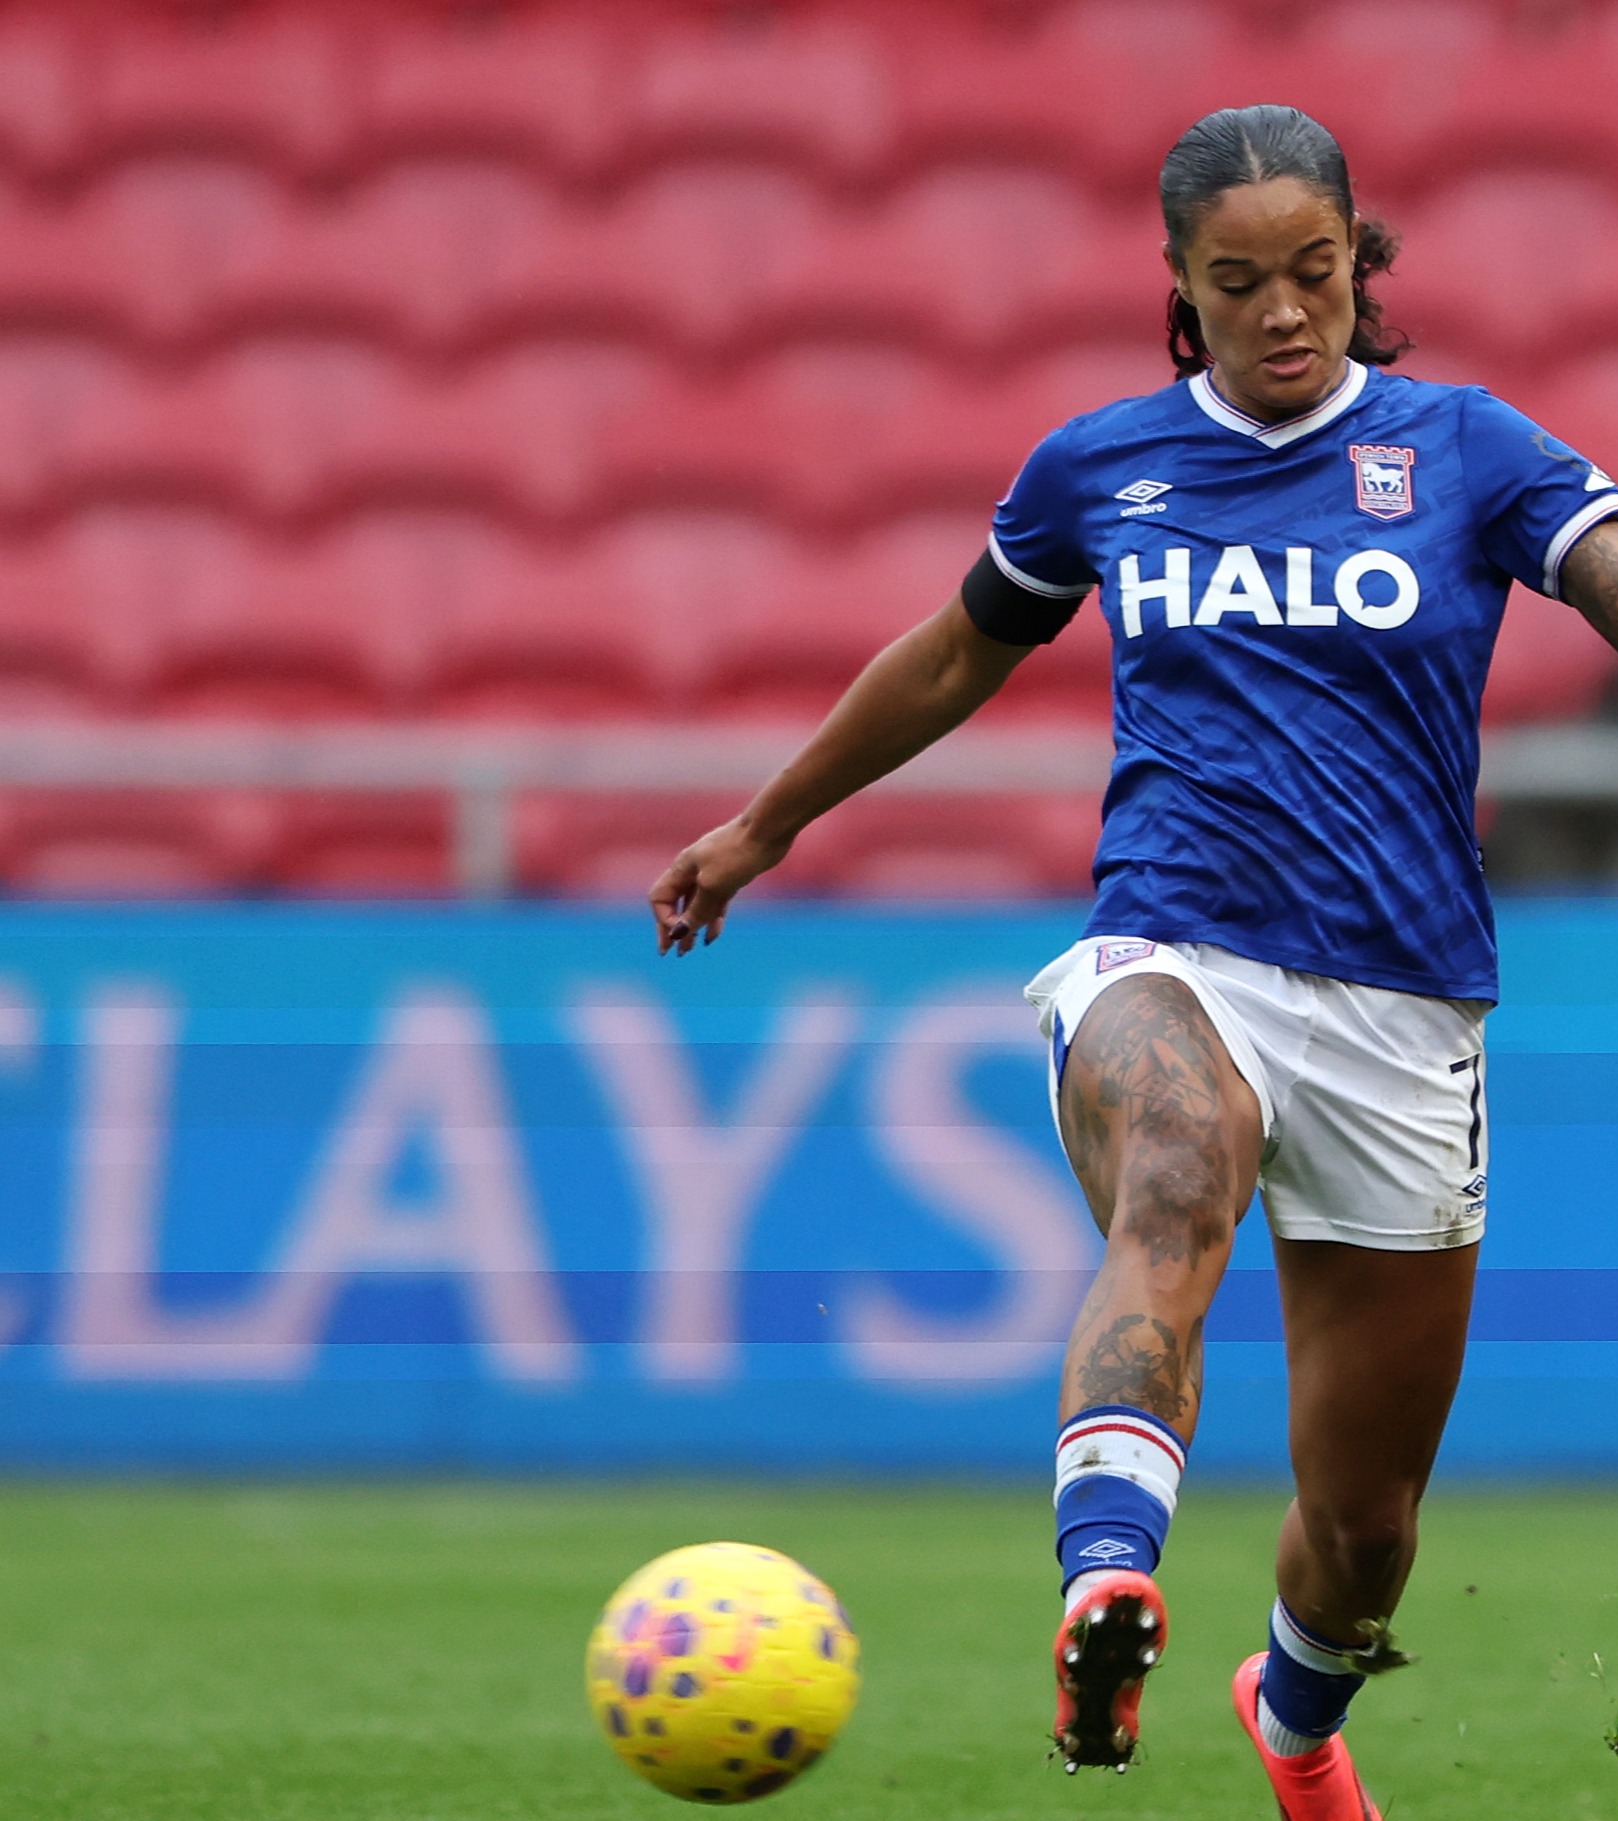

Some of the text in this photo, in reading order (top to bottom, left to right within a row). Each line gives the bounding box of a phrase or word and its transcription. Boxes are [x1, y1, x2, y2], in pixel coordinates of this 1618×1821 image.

[1120, 502, 1167, 517] umbro
[1119, 545, 1419, 638] HALO
[1449, 1053, 1481, 1169] 7
[0, 978, 1098, 1388] LAYS
